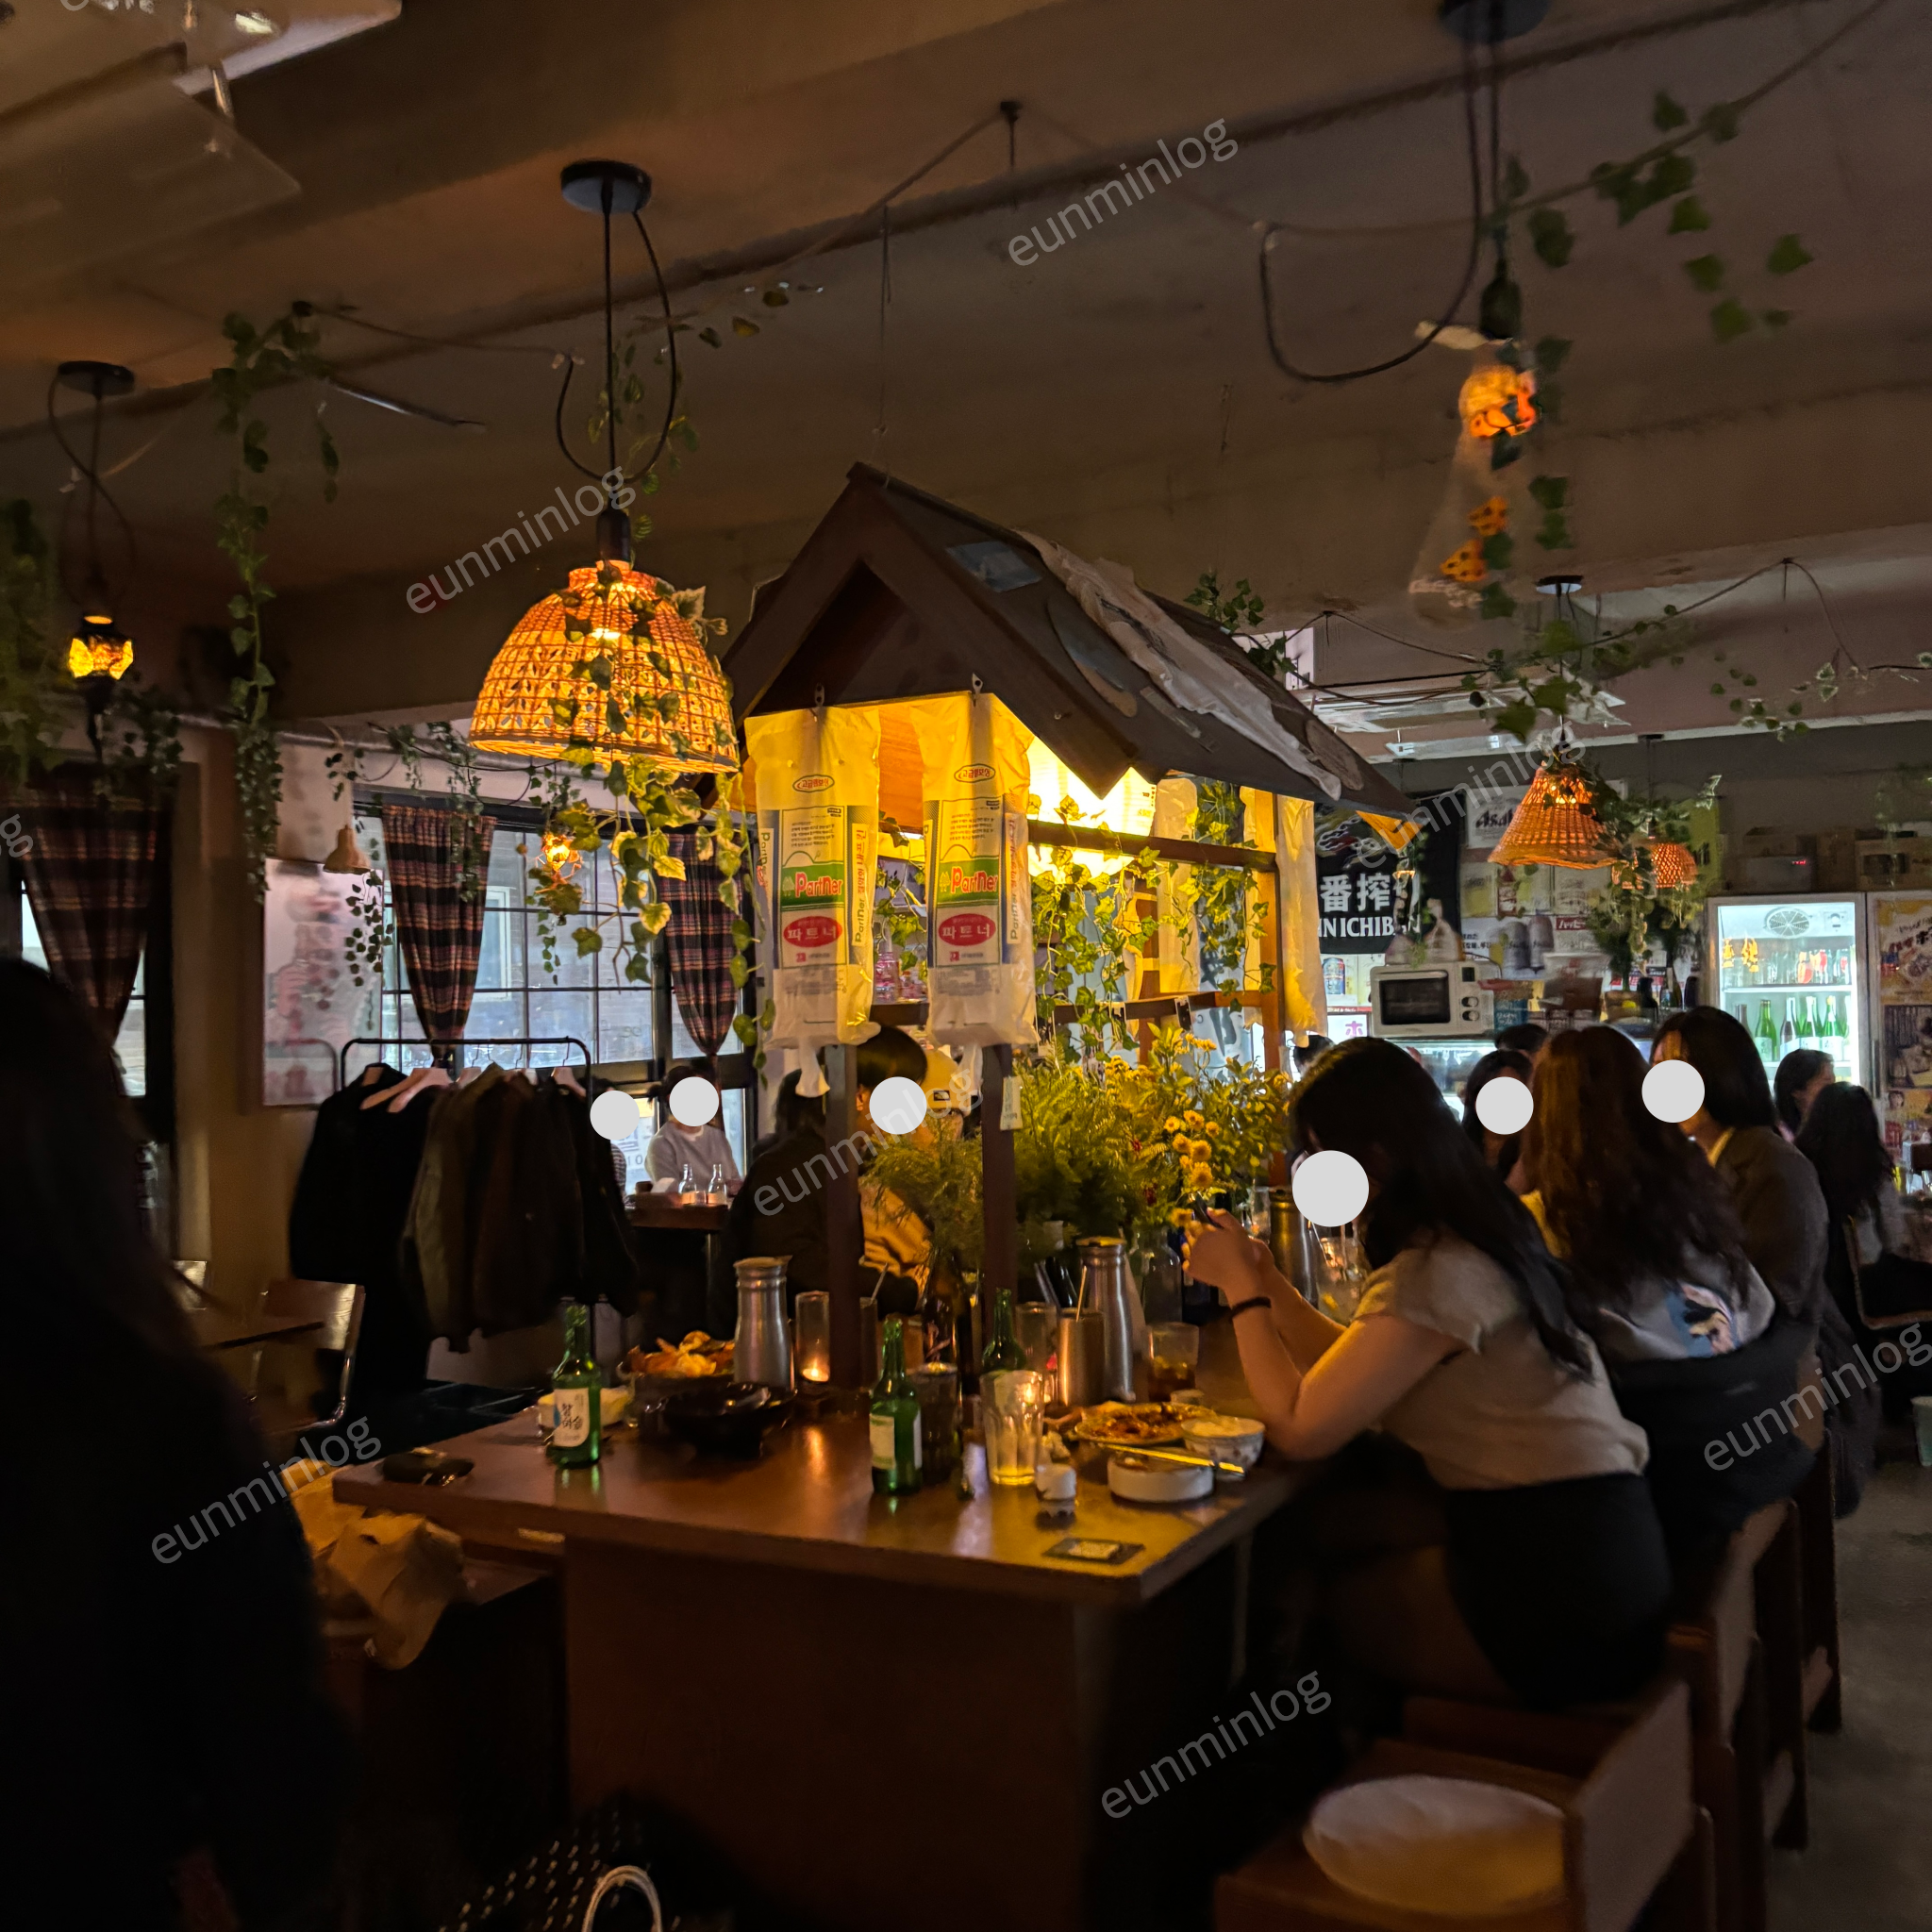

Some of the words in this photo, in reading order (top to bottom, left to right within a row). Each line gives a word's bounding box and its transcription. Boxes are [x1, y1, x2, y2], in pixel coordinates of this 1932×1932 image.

[795, 871, 843, 899] Partner
[951, 866, 999, 894] Partner
[788, 924, 837, 941] 파트너
[942, 923, 991, 940] 파트너
[1340, 916, 1421, 938] ICHIBN
